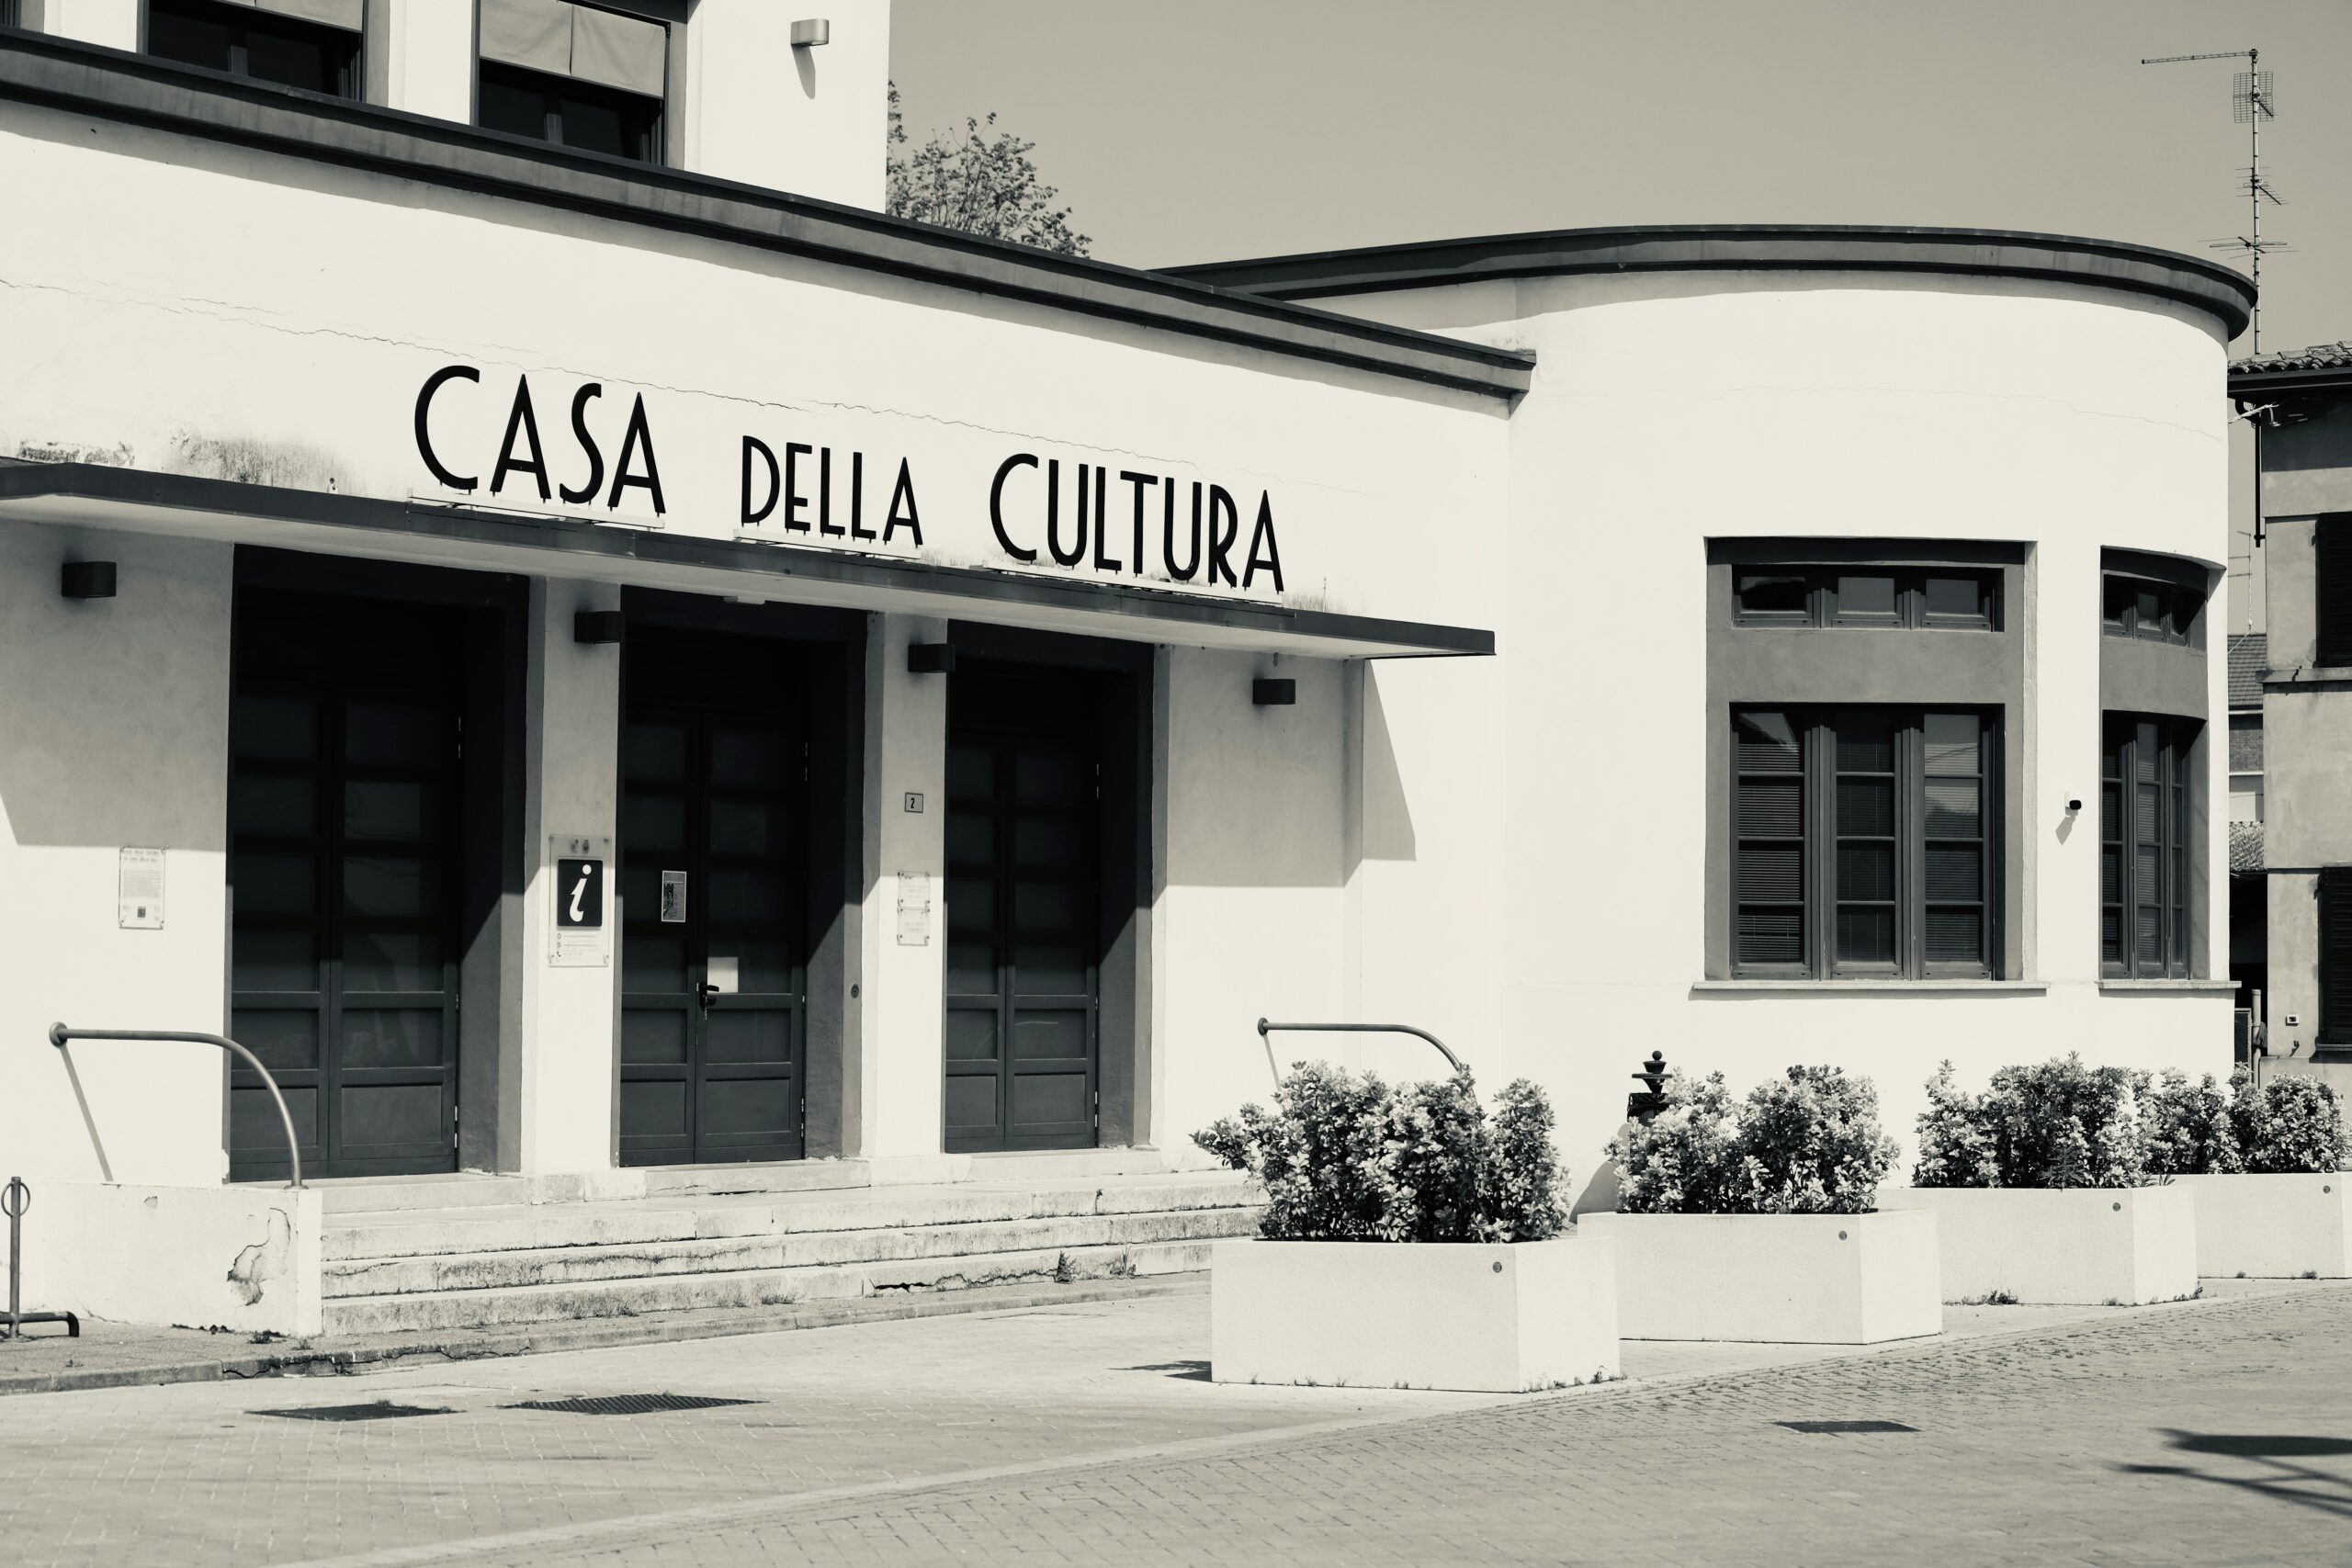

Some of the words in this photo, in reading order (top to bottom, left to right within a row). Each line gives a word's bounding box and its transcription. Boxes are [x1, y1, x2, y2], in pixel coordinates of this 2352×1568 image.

[414, 365, 667, 516] CASA
[741, 434, 924, 548] DELLA
[989, 453, 1285, 594] CULTURA
[910, 796, 915, 809] 2
[570, 864, 592, 921] i
